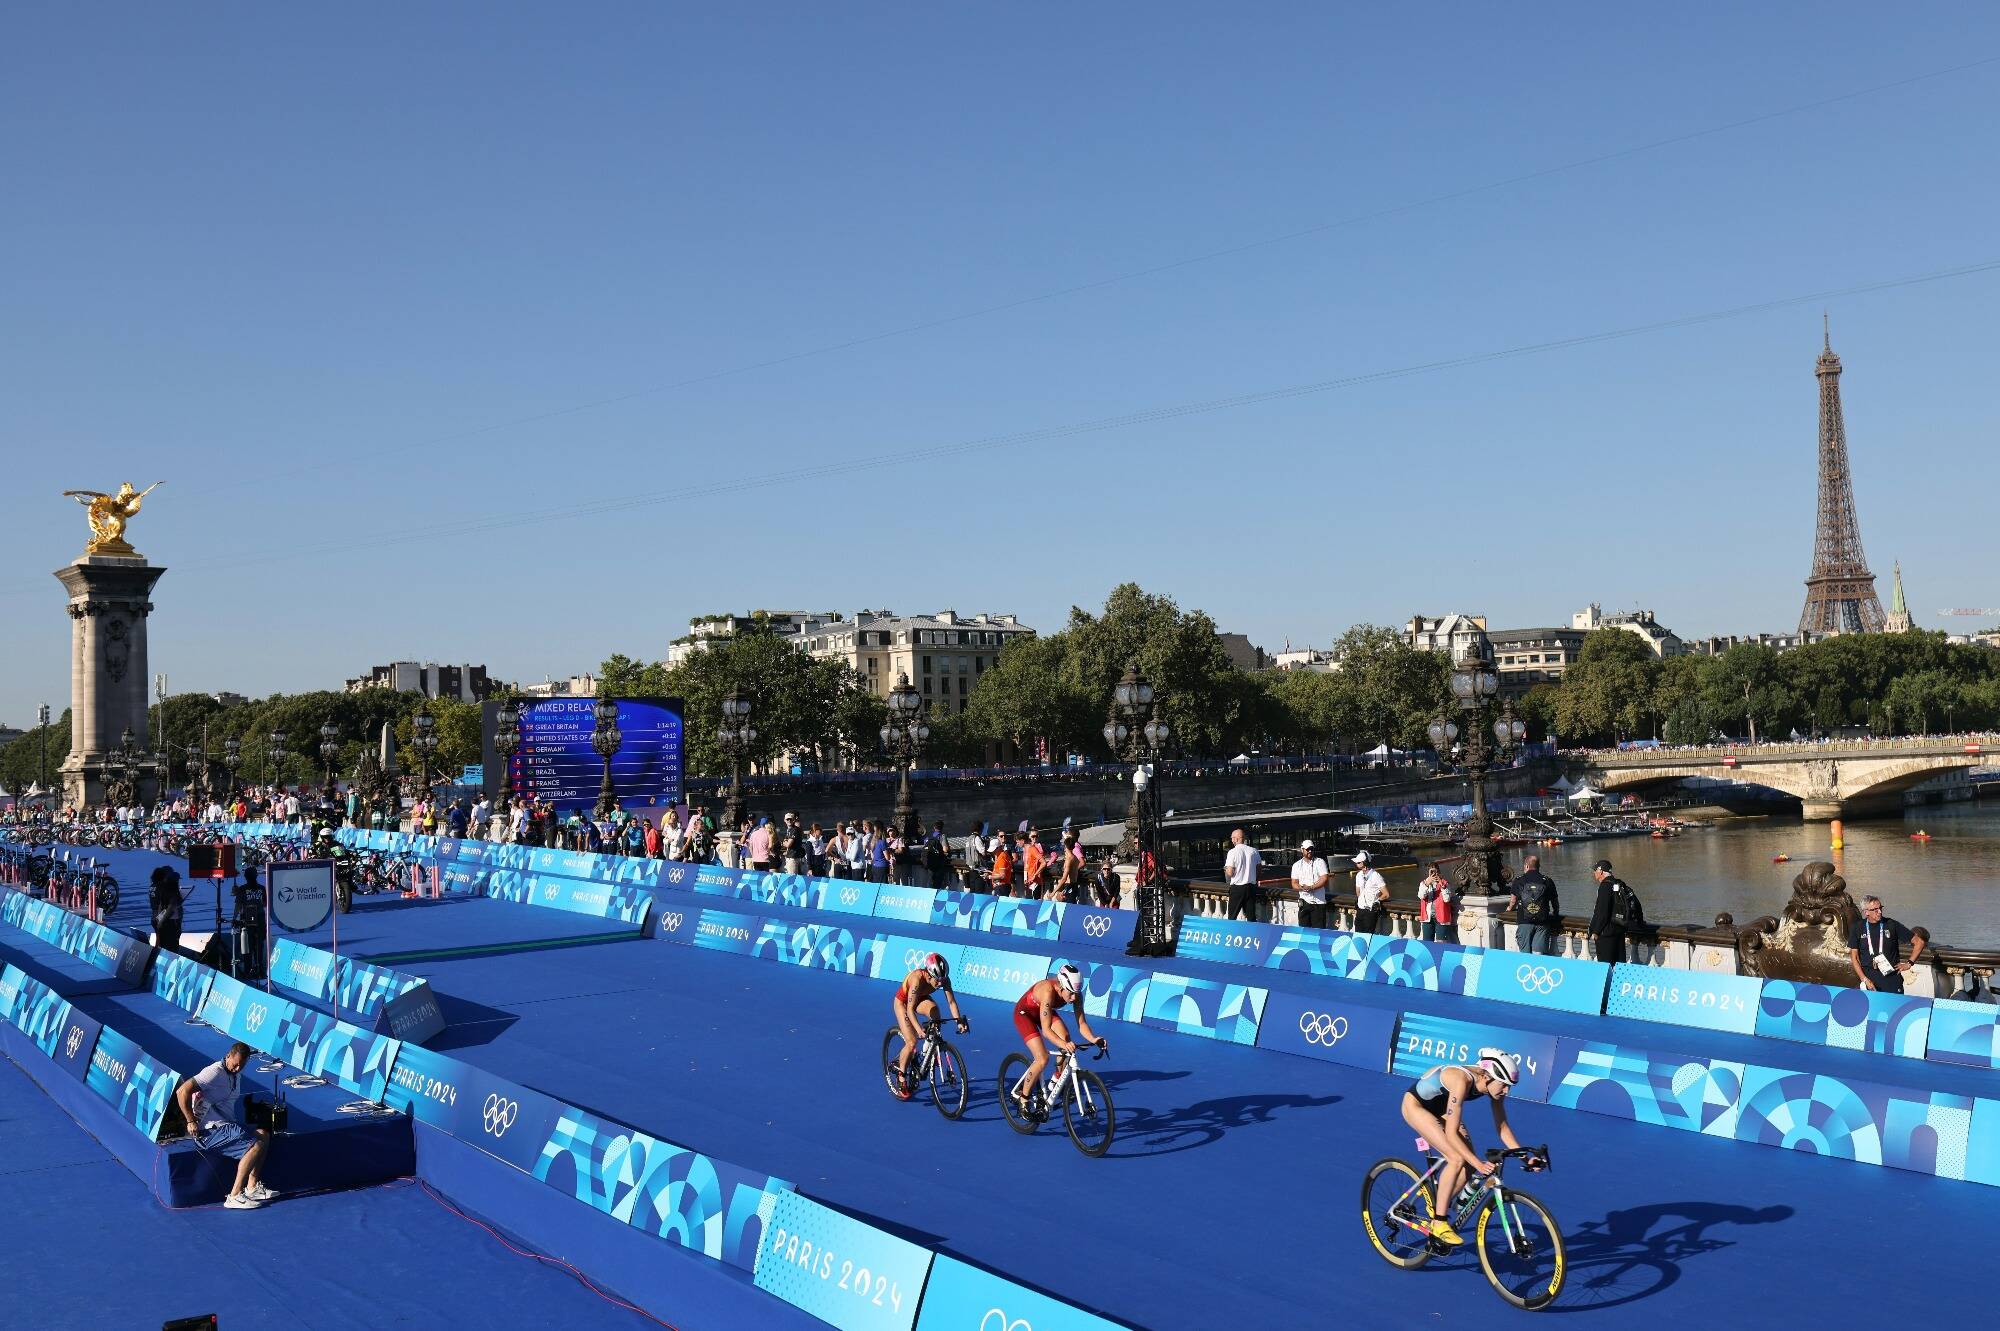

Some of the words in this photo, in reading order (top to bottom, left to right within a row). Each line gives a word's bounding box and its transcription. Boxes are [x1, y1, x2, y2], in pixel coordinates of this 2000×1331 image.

[535, 703, 565, 712] MIXED
[715, 876, 733, 887] 2024
[700, 922, 724, 937] PARIS
[725, 926, 749, 940] 2024
[1184, 930, 1221, 945] PARIS
[1224, 934, 1260, 951] 2024
[963, 962, 999, 981] PARIS
[1002, 968, 1037, 985] 2024
[1621, 982, 1680, 1004] PARIS
[1687, 990, 1745, 1012] 2024
[416, 1000, 438, 1021] 2024
[1408, 1035, 1469, 1062] PARIS
[394, 1066, 425, 1092] PARIS
[424, 1078, 457, 1106] 2024
[773, 1228, 833, 1280] PARIS
[837, 1259, 902, 1313] 2024
